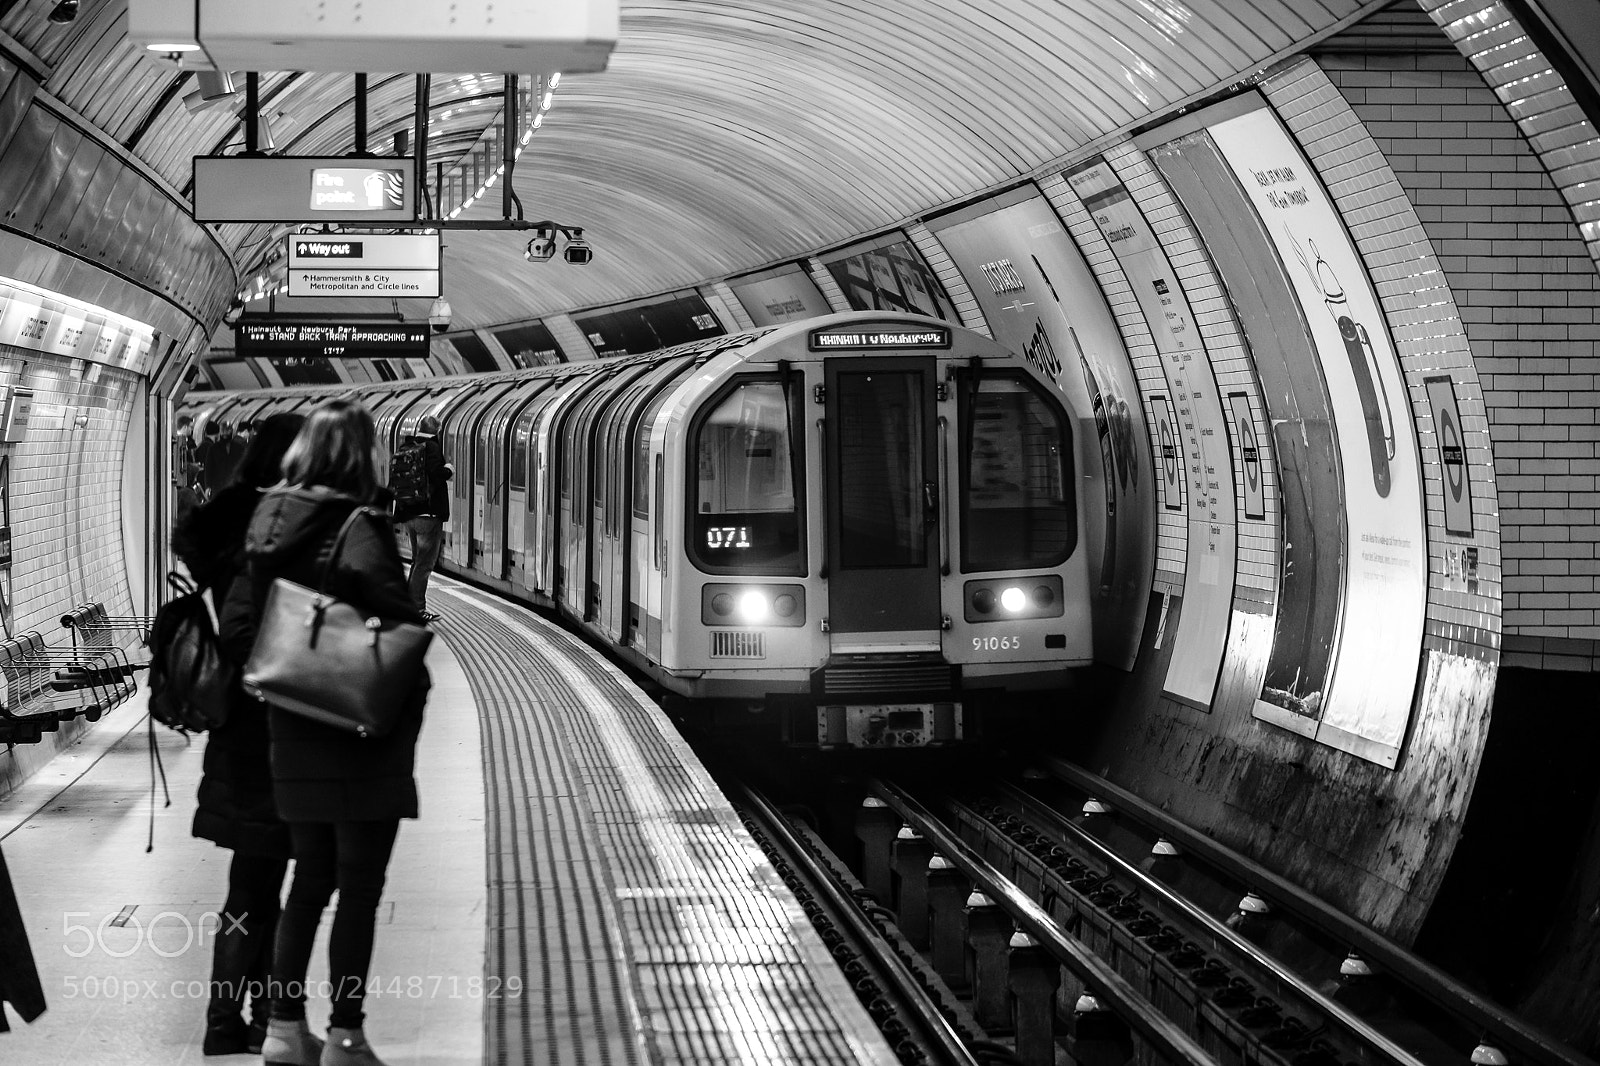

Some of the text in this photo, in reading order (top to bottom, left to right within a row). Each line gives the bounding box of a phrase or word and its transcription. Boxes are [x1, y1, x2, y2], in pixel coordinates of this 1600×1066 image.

[316, 173, 344, 187] Fire
[316, 190, 355, 206] point
[308, 243, 351, 257] Way out
[373, 275, 390, 283] City
[987, 258, 1025, 293] STARTS
[310, 283, 359, 291] Metropolitan
[241, 326, 246, 334] 1
[269, 333, 406, 342] STAND BACK TRAIN APPROACHING
[707, 527, 750, 548] 071
[972, 636, 1021, 651] 91065
